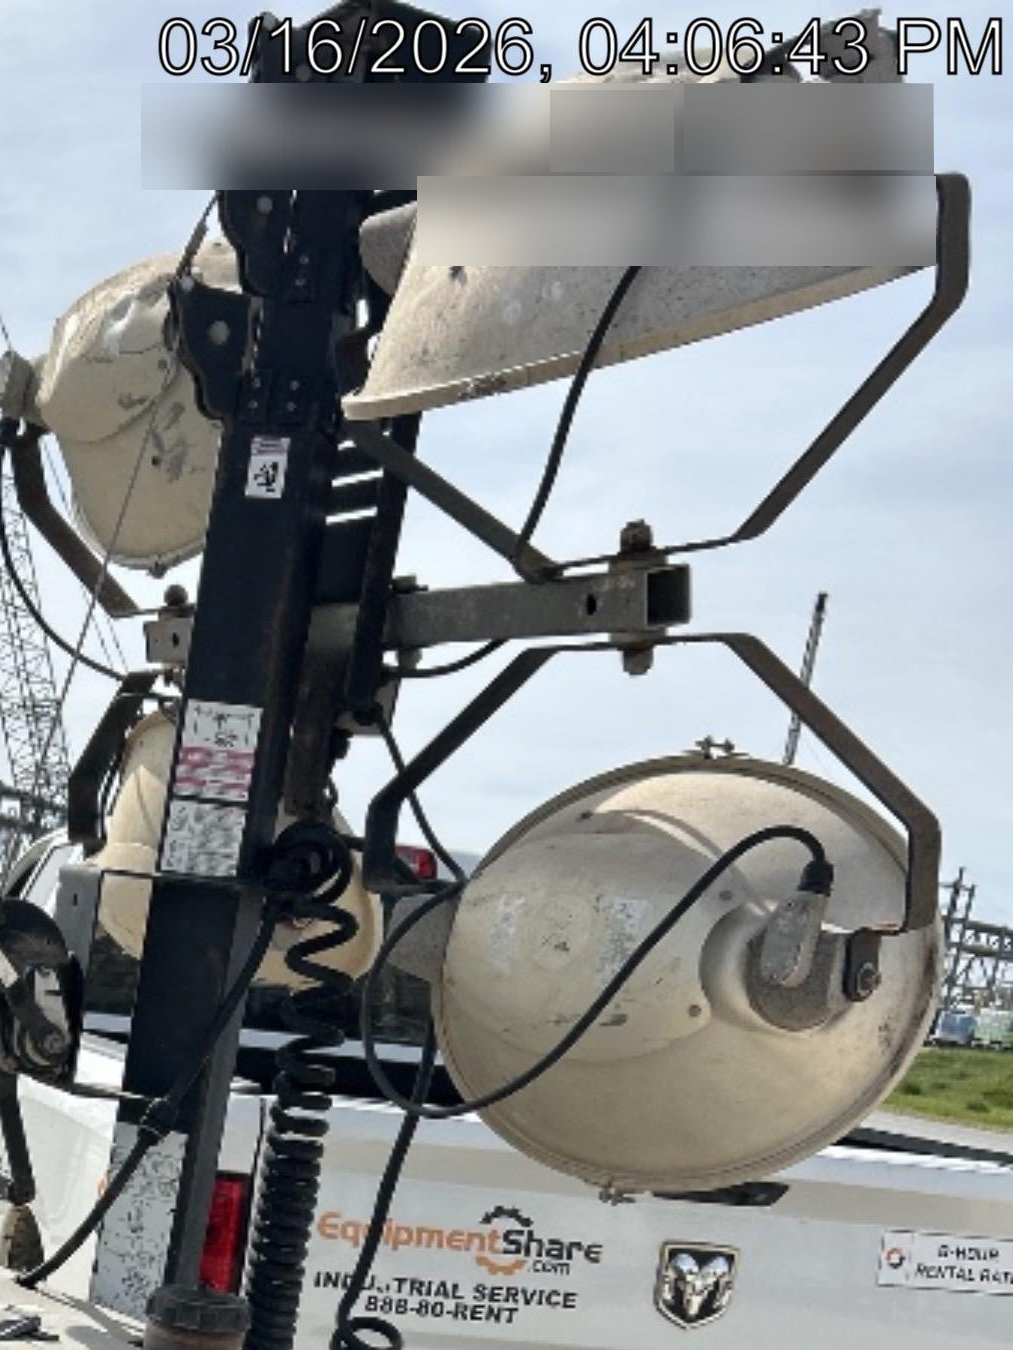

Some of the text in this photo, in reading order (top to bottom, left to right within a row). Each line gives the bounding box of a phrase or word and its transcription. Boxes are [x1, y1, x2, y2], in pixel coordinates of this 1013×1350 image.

[317, 1211, 603, 1264] EqipmentShare
[979, 1268, 1013, 1285] RAT
[364, 1295, 519, 1324] 888-80-RENT
[472, 1282, 579, 1310] SERVICE
